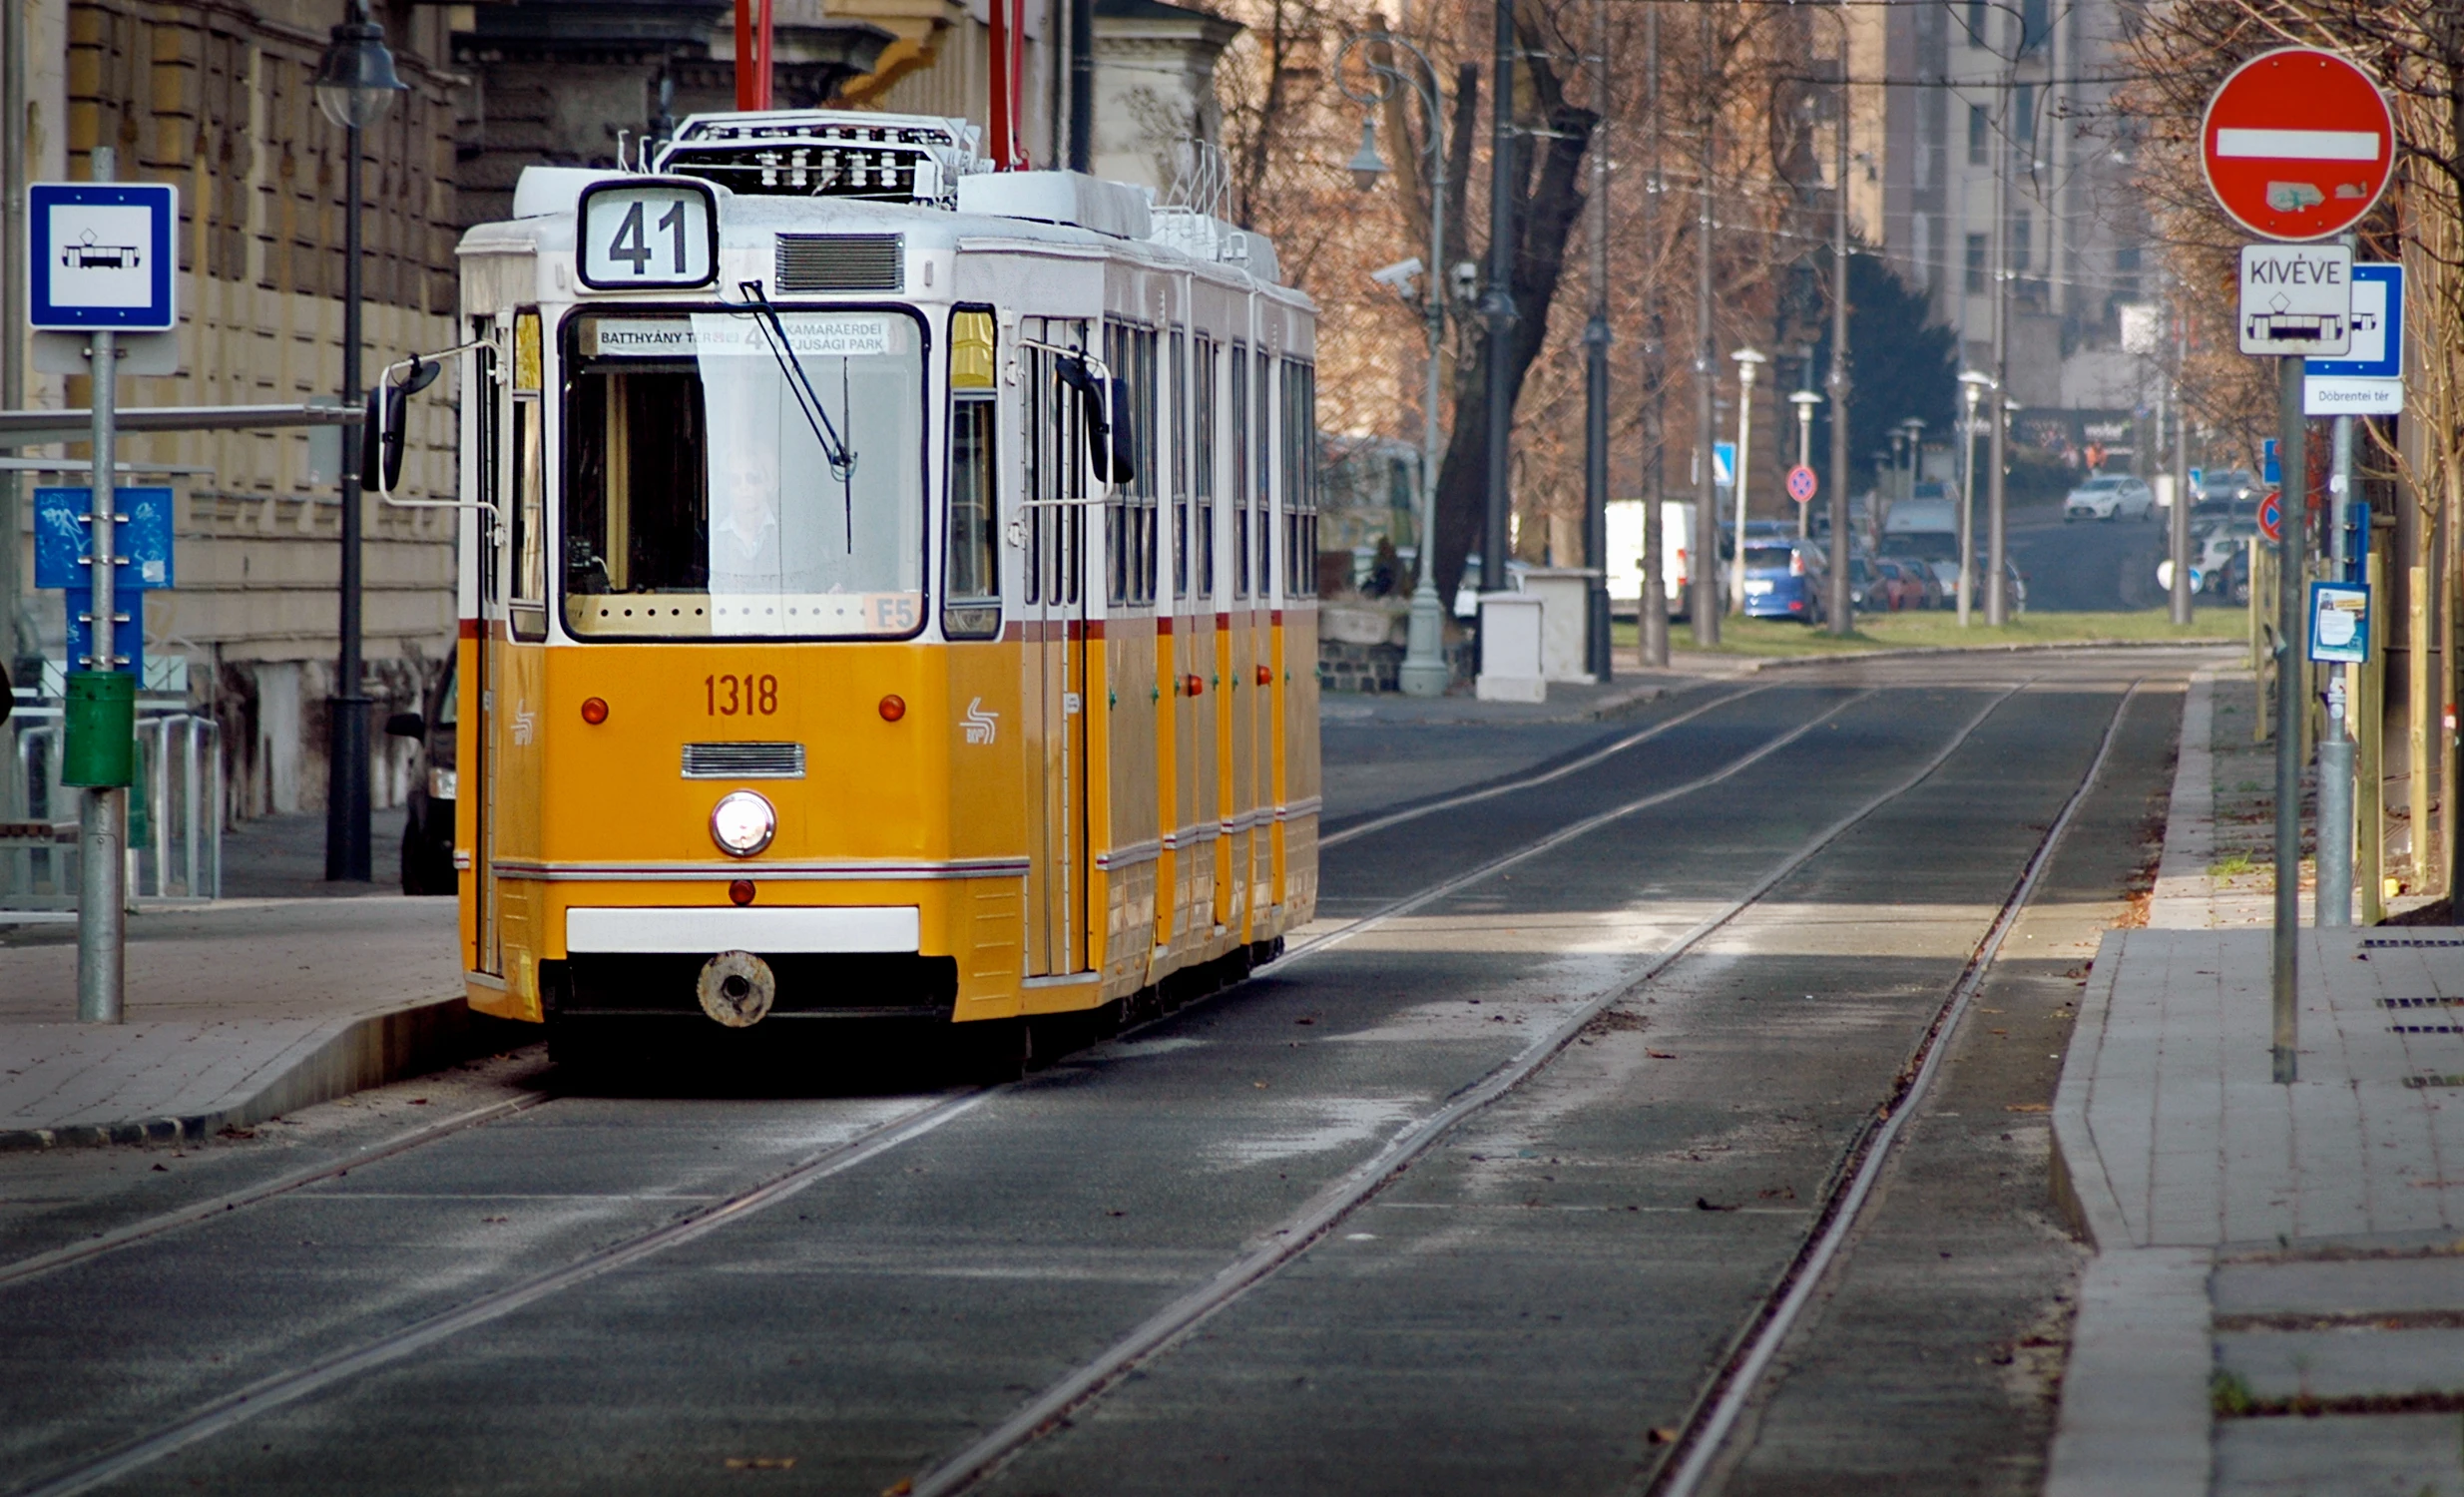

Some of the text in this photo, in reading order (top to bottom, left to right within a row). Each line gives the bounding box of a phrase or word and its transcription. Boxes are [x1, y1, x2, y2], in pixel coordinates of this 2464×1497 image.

[609, 201, 686, 274] 41
[2250, 252, 2340, 283] KIVÉVE
[601, 330, 683, 343] BATTHYÁNY
[849, 338, 883, 350] PARK
[2318, 390, 2390, 401] Döbrentei tér
[705, 674, 777, 716] 1318
